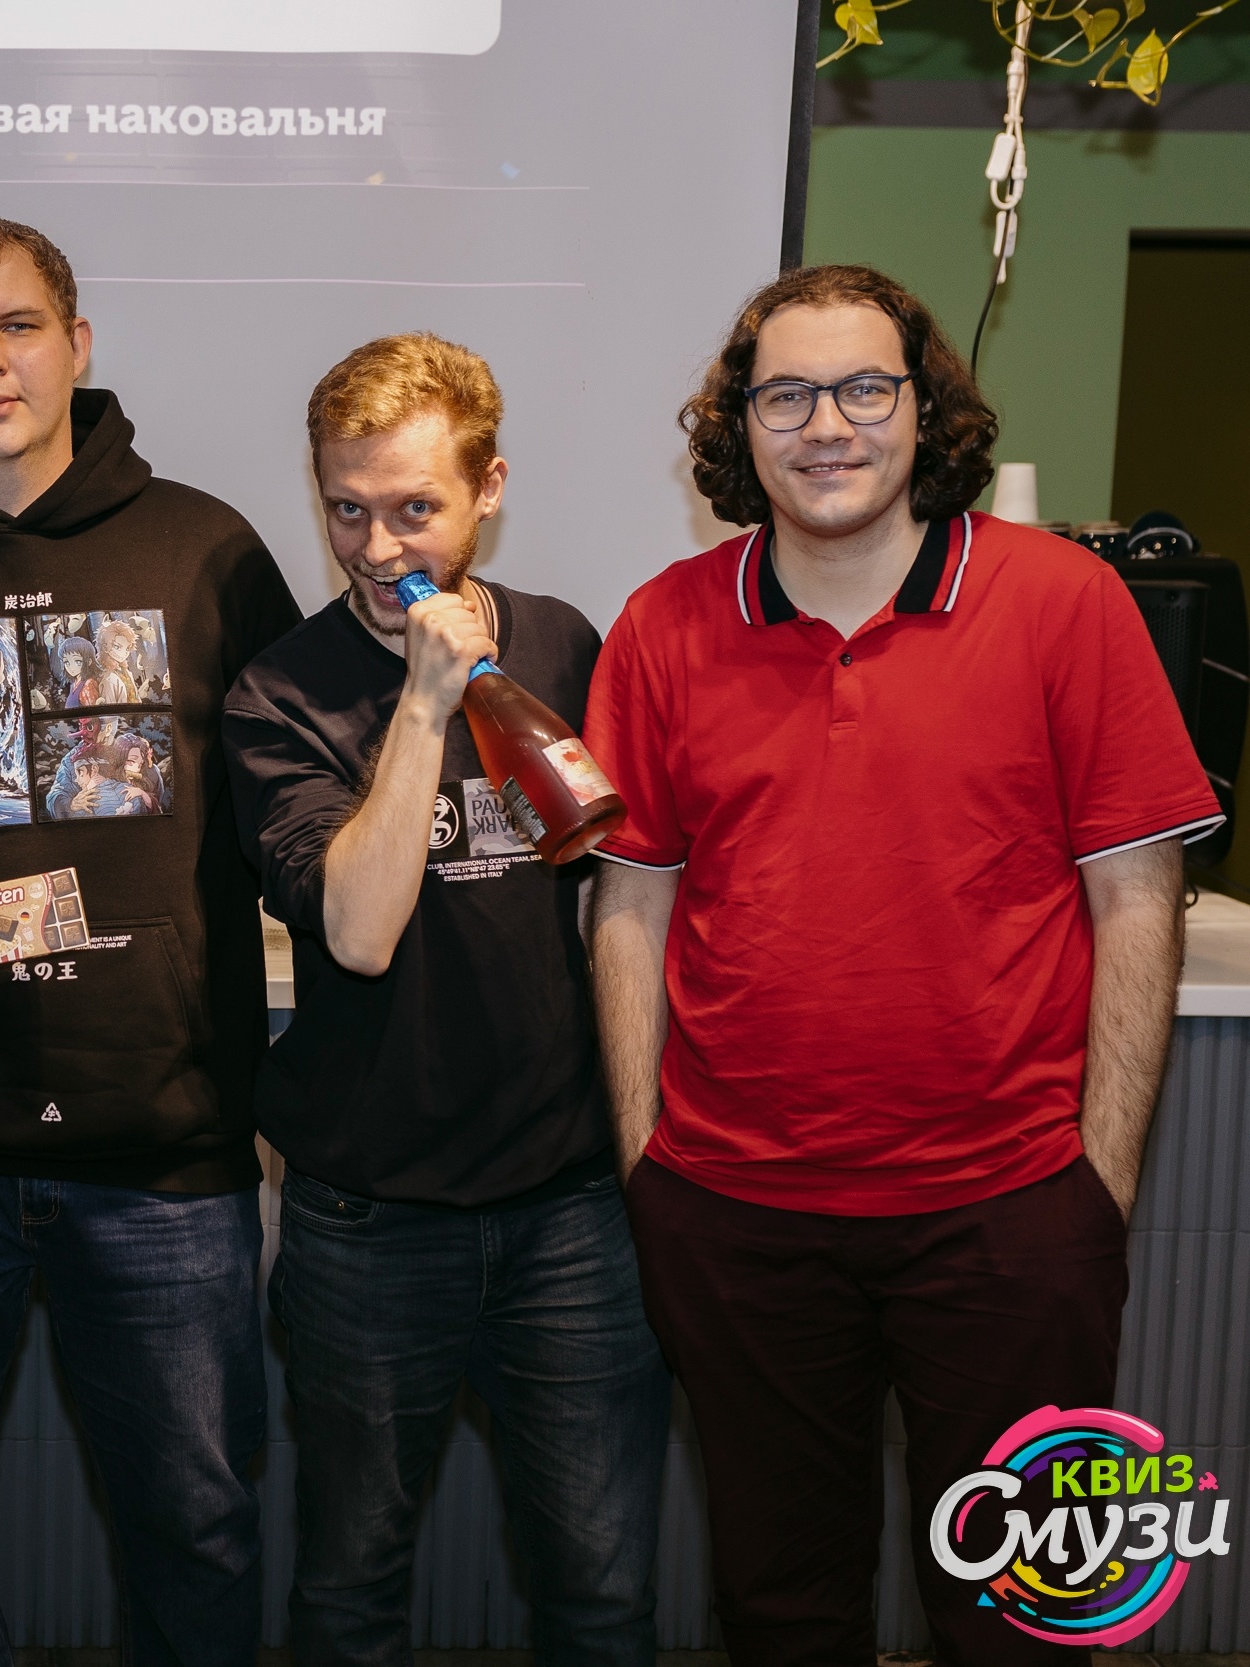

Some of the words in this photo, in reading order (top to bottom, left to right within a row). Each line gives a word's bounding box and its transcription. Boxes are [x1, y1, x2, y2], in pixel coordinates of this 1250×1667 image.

[86, 104, 387, 136] наковальня
[4, 591, 53, 610] 炭治郎
[471, 797, 507, 817] PAU
[488, 856, 511, 865] OCEAN
[443, 873, 480, 882] ESTABLISHED
[11, 961, 78, 981] 鬼の王
